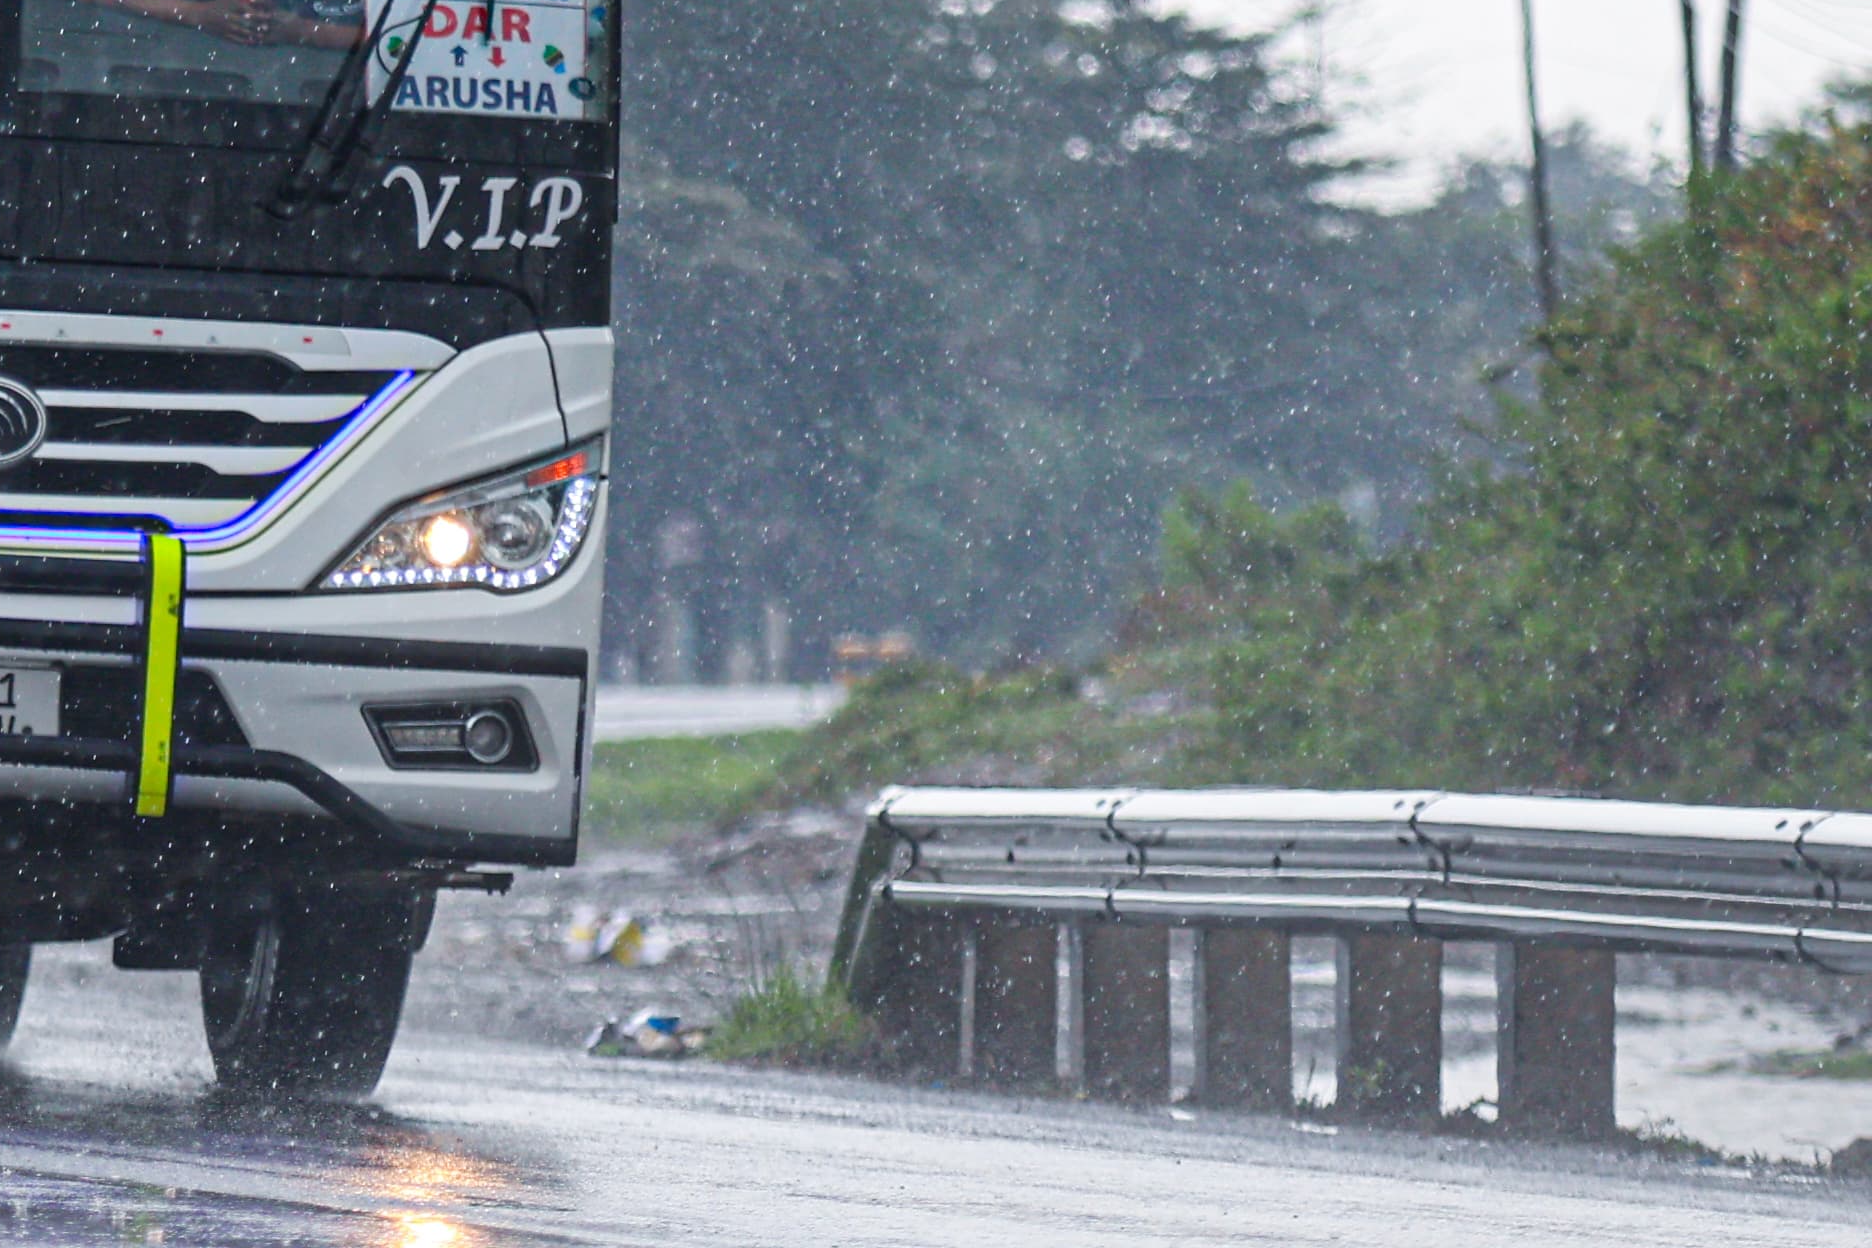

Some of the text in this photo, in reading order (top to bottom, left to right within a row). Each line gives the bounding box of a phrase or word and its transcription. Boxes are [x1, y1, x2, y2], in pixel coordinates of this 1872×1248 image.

[422, 4, 532, 43] DAR
[395, 74, 559, 115] ARUSHA
[381, 164, 583, 251] V.I.P
